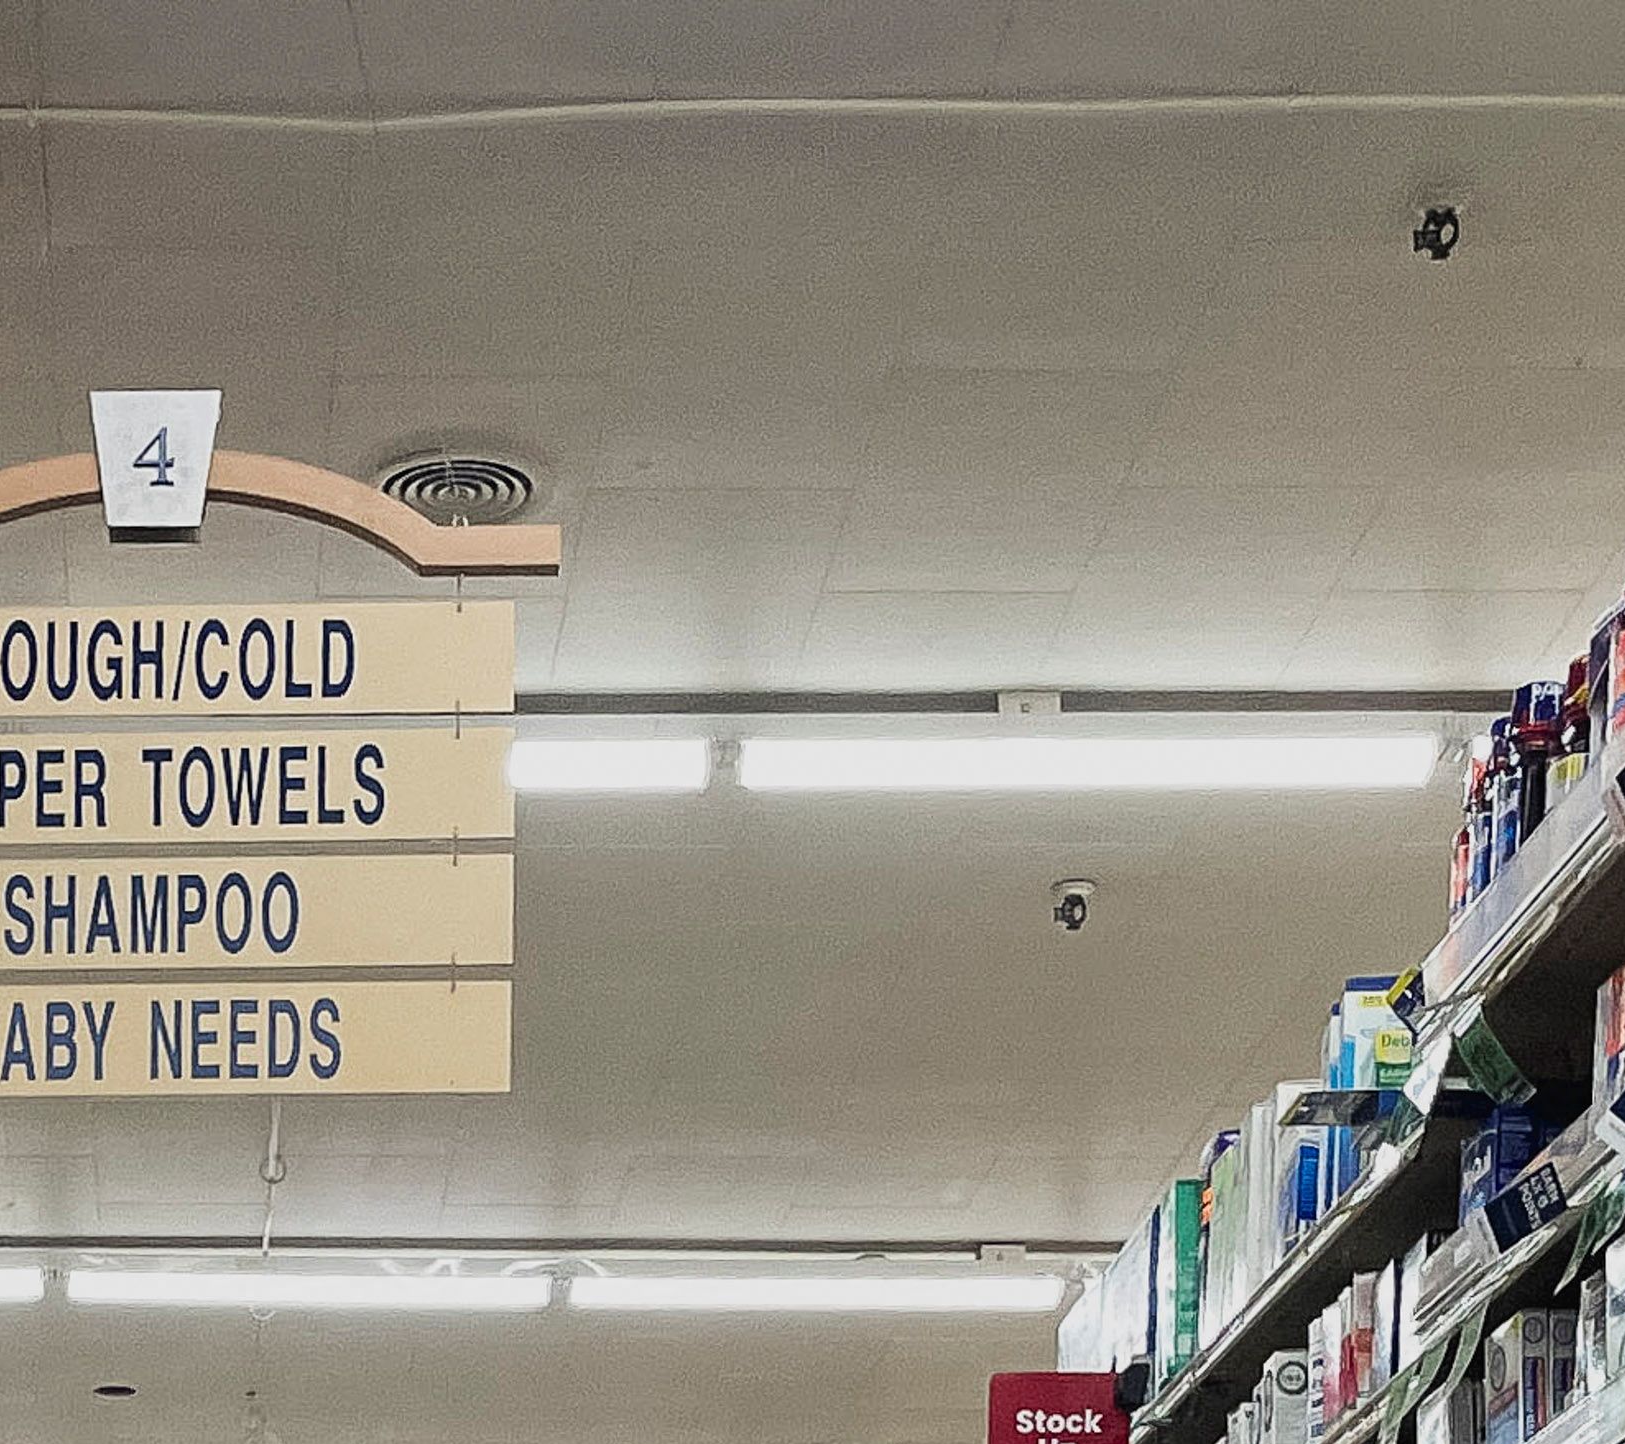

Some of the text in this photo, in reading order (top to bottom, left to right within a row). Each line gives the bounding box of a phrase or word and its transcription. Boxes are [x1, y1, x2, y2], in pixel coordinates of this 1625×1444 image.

[131, 425, 176, 487] 4
[141, 742, 388, 827] TOWELS
[3, 870, 300, 956] SHAMPOO
[149, 997, 343, 1082] NEEDS
[1015, 1408, 1103, 1435] Stock
